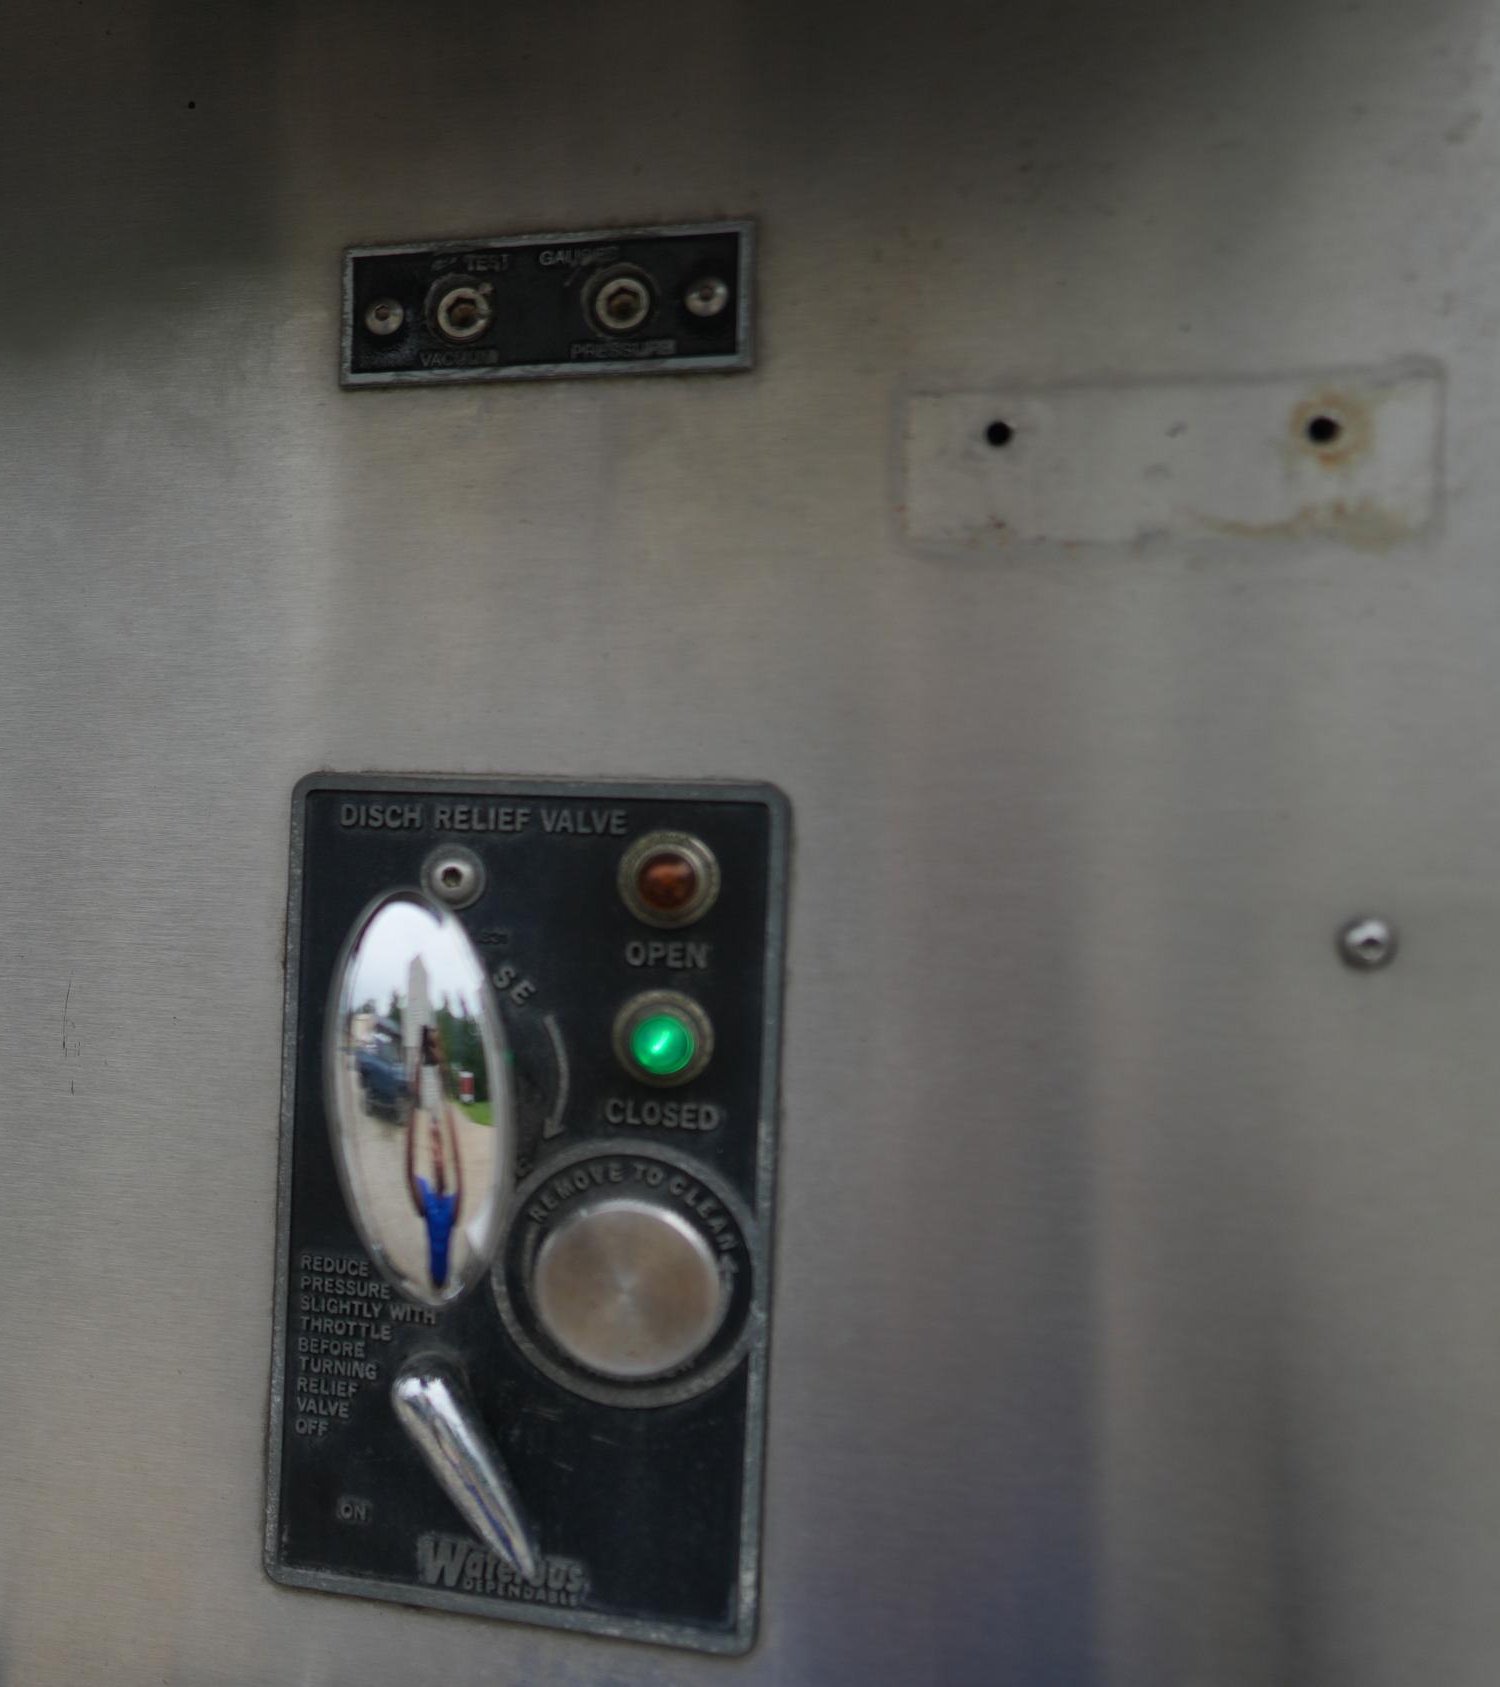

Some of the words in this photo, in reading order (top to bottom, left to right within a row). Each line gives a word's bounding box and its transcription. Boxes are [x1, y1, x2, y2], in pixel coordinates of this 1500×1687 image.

[340, 803, 422, 829] DISCH
[434, 804, 531, 832] RELIEF
[540, 808, 628, 836] VALVE
[624, 941, 707, 968] OPEN
[605, 1100, 719, 1131] CLOSED
[527, 1161, 625, 1224] REMOVE
[632, 1161, 664, 1187] TO
[669, 1174, 739, 1251] CLEAN
[301, 1255, 369, 1277] REDUCE
[301, 1276, 391, 1300] PRESSURE
[301, 1295, 382, 1318] SLIGHTLY
[389, 1304, 436, 1326] WITH
[300, 1316, 392, 1341] THROTTLE
[299, 1337, 365, 1358] BEFORE
[299, 1356, 377, 1380] TURNING
[297, 1377, 358, 1398] RELIEF
[296, 1397, 349, 1419] VALVE
[295, 1418, 329, 1437] OFF
[339, 1503, 367, 1521] ON
[463, 1577, 580, 1608] DEPENDABLE
